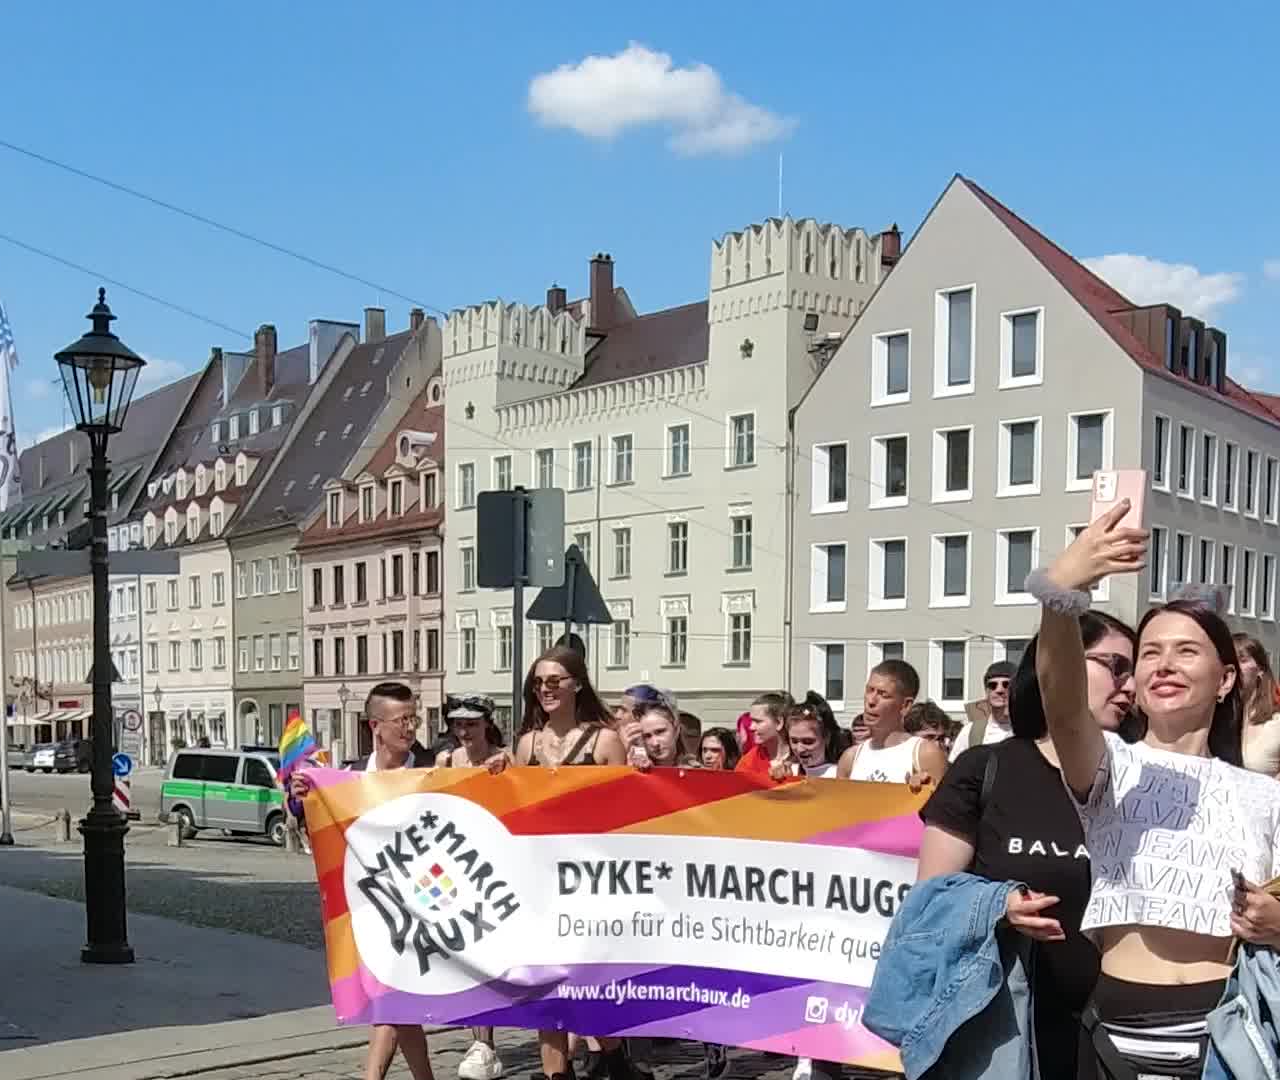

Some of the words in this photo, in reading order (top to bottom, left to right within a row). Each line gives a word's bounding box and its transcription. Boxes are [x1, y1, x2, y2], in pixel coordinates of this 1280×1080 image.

[1008, 838, 1091, 859] BALA
[434, 821, 521, 922] MARCH
[685, 862, 816, 908] MARCH
[412, 901, 497, 977] AUX
[557, 913, 624, 938] Demo
[632, 910, 666, 938] für
[671, 912, 705, 940] die
[711, 915, 836, 953] Sichtbarkeit
[557, 980, 751, 1010] www.dykemarchaux.de
